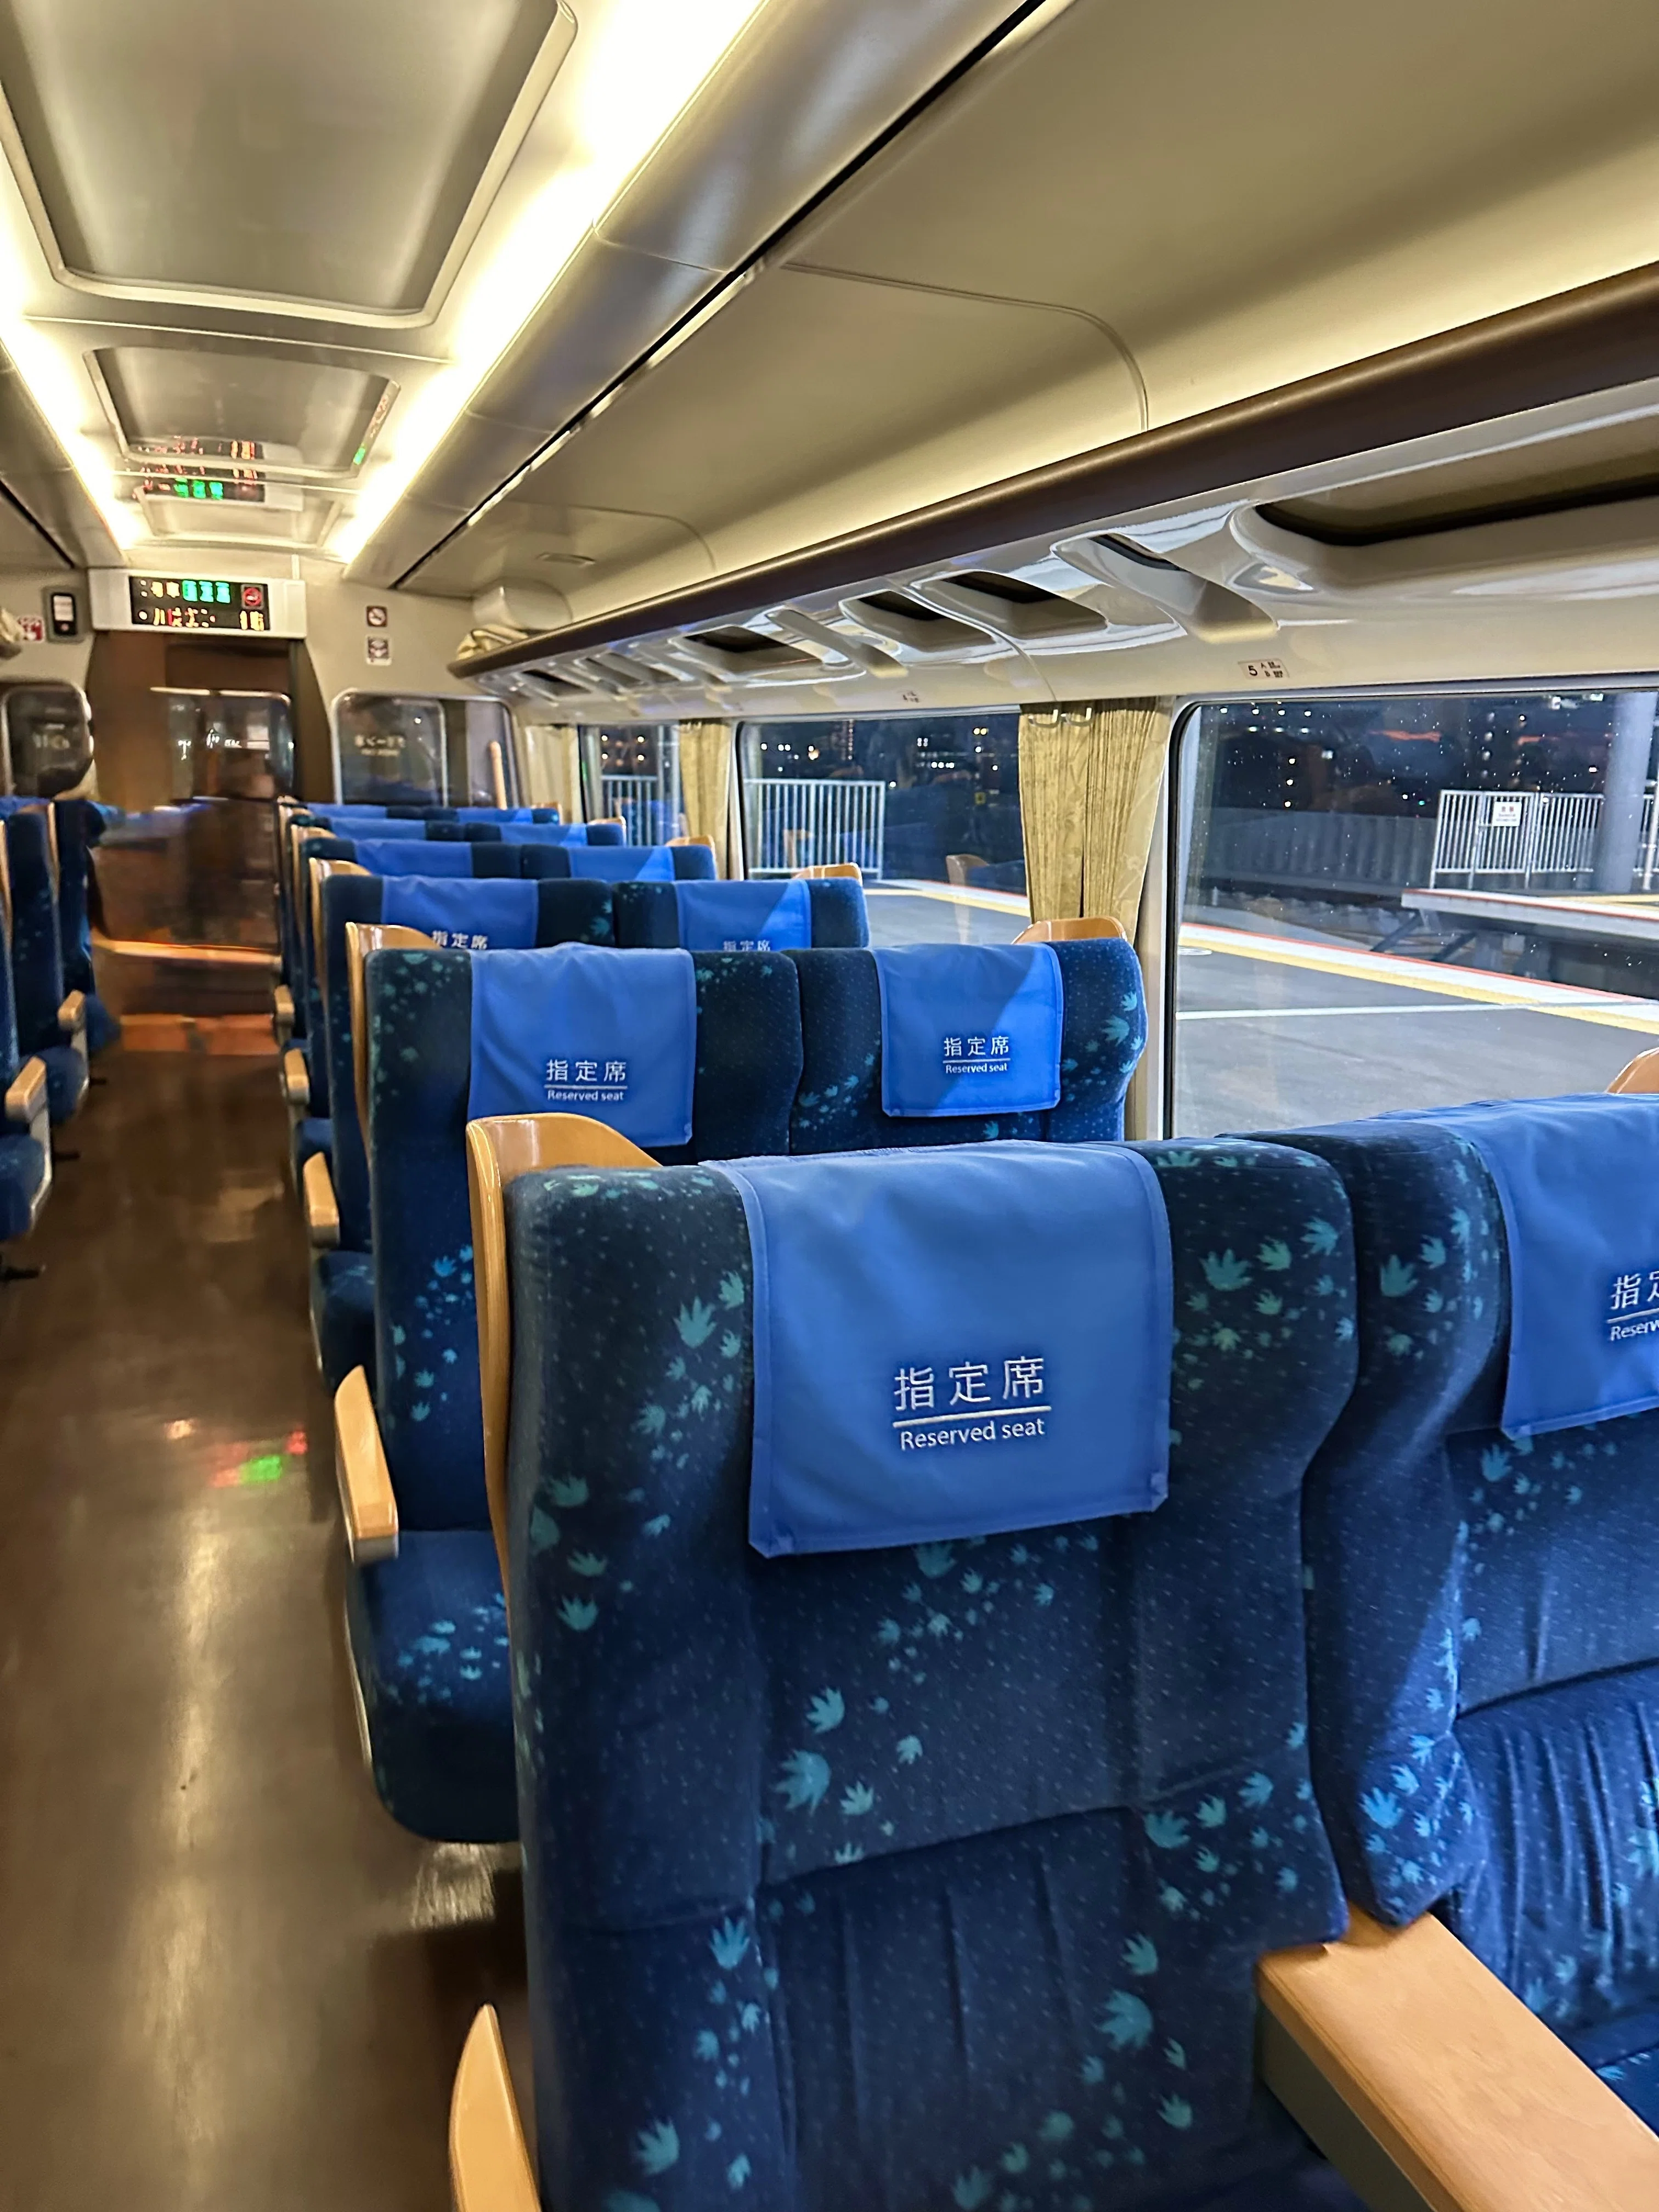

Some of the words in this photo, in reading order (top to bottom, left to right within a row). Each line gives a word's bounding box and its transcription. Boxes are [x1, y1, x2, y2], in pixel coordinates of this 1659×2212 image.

[1248, 665, 1258, 676] 5
[944, 1036, 1009, 1056] 指定席
[546, 1059, 627, 1082] 指定席
[945, 1063, 988, 1074] Reserved
[989, 1063, 1008, 1071] seat
[548, 1090, 599, 1102] Reserved
[601, 1091, 624, 1101] seat
[894, 1356, 1044, 1411] 指定席
[900, 1420, 996, 1451] Reserved
[1002, 1418, 1045, 1439] seat
